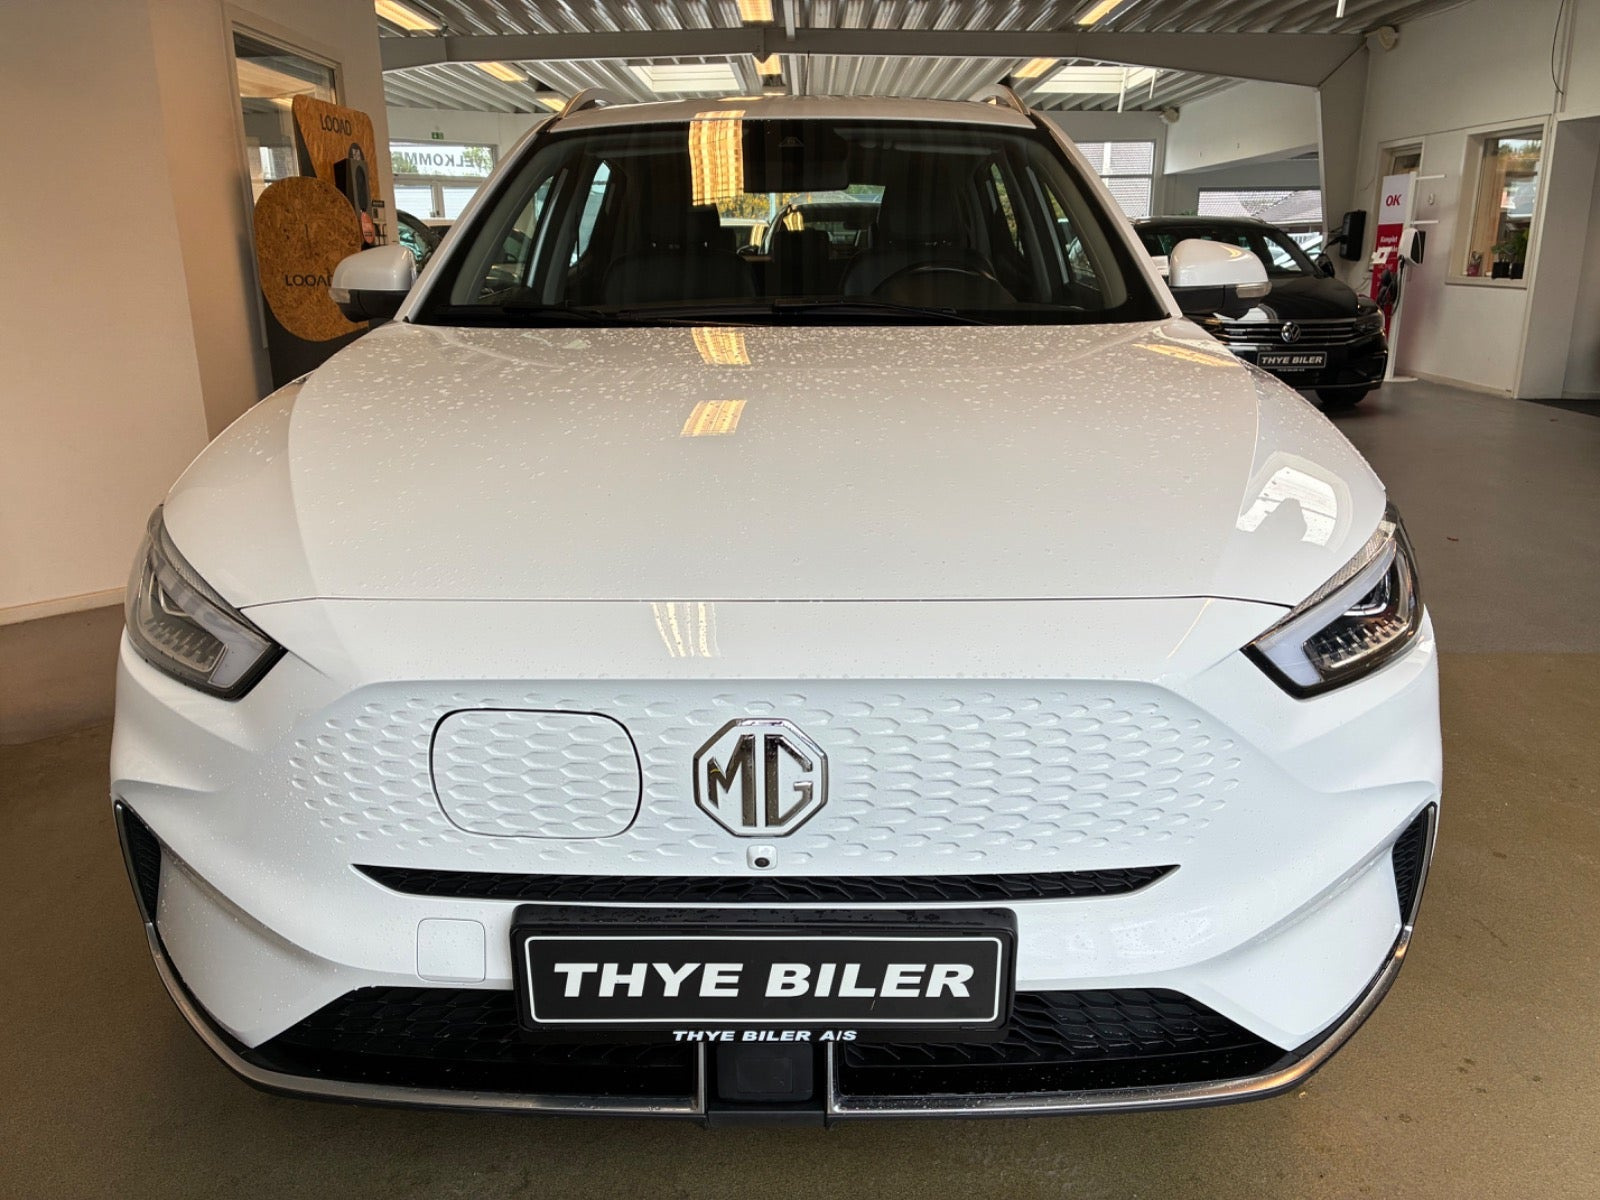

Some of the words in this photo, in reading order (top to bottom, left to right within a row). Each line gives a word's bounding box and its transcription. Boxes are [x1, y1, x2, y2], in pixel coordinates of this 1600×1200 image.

[1386, 194, 1402, 207] OK
[1262, 356, 1290, 364] THYE
[1292, 355, 1323, 364] BILER
[706, 734, 813, 827] MG
[553, 963, 743, 998] THYE
[764, 963, 975, 998] BILER
[673, 1030, 736, 1042] THYE
[742, 1030, 811, 1042] BILER
[819, 1030, 858, 1042] A/S
